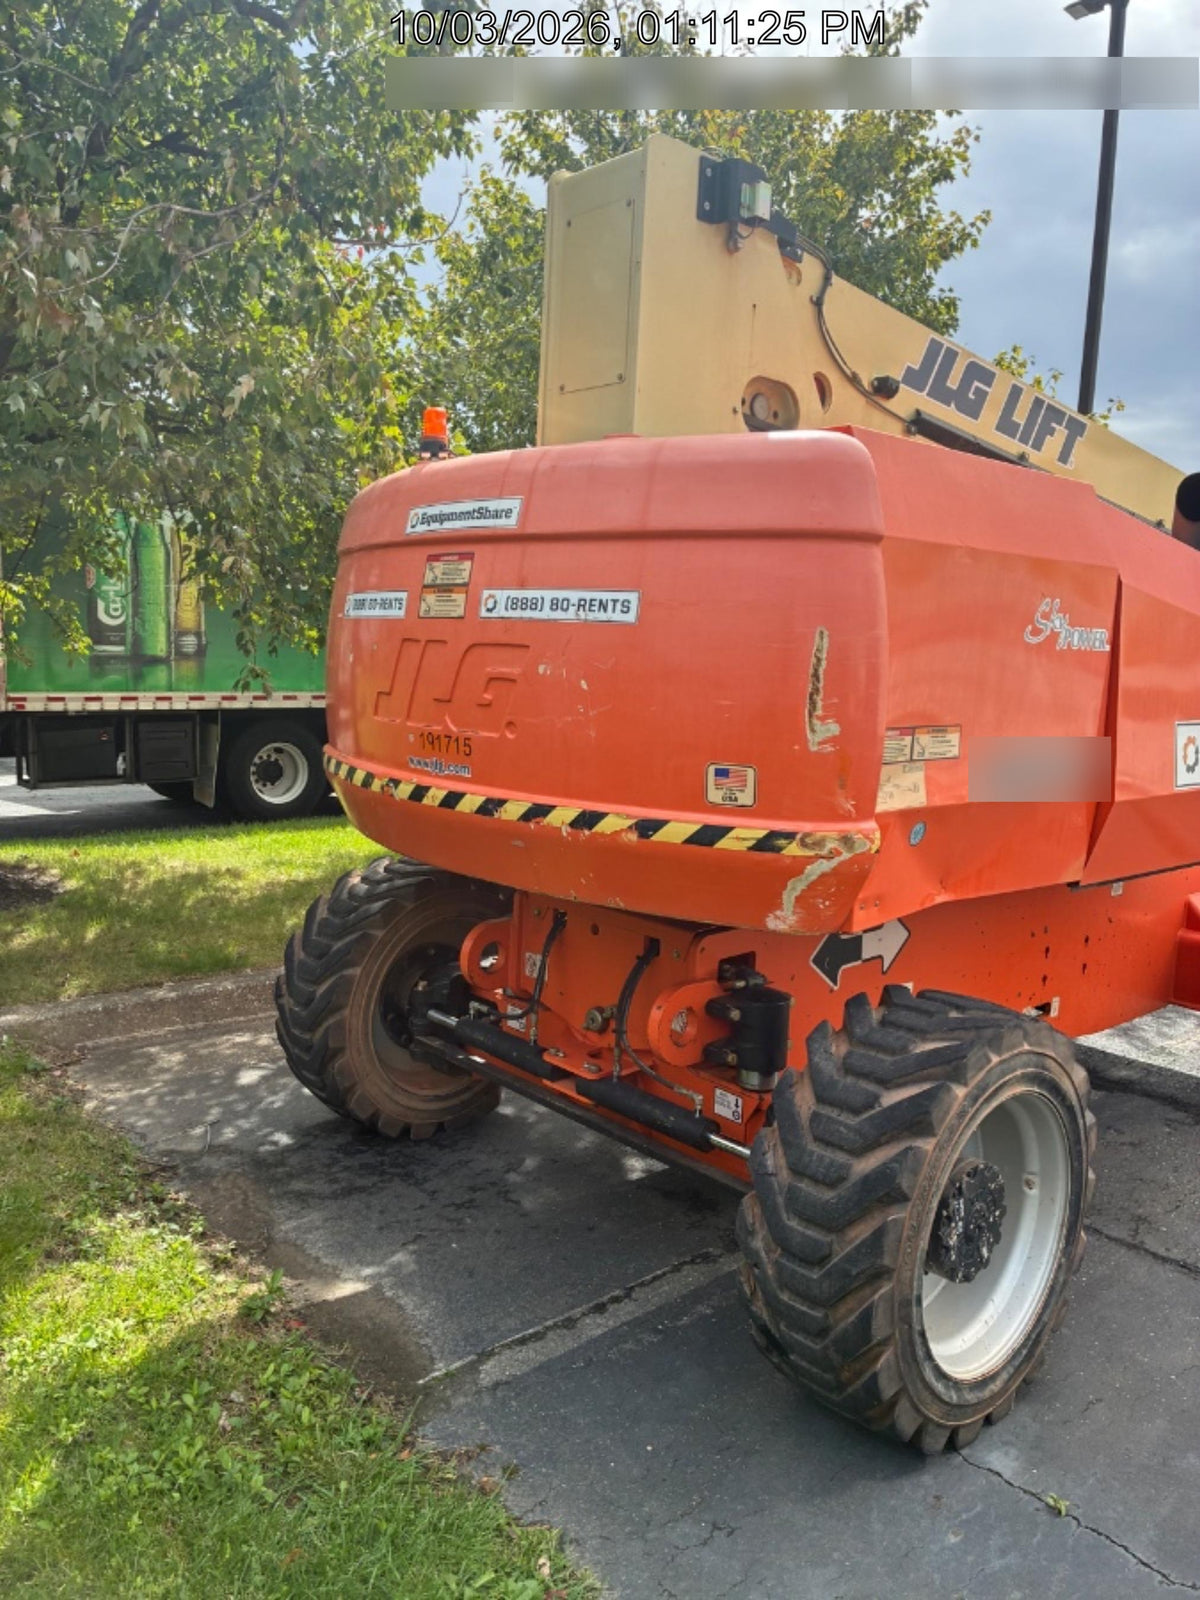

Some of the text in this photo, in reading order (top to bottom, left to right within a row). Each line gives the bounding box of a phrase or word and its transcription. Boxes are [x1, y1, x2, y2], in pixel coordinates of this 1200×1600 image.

[901, 336, 1089, 469] JLG LIFT
[419, 505, 513, 527] EquipmentShare
[504, 595, 632, 615] (888) 80-RENTS
[419, 731, 473, 757] 191715
